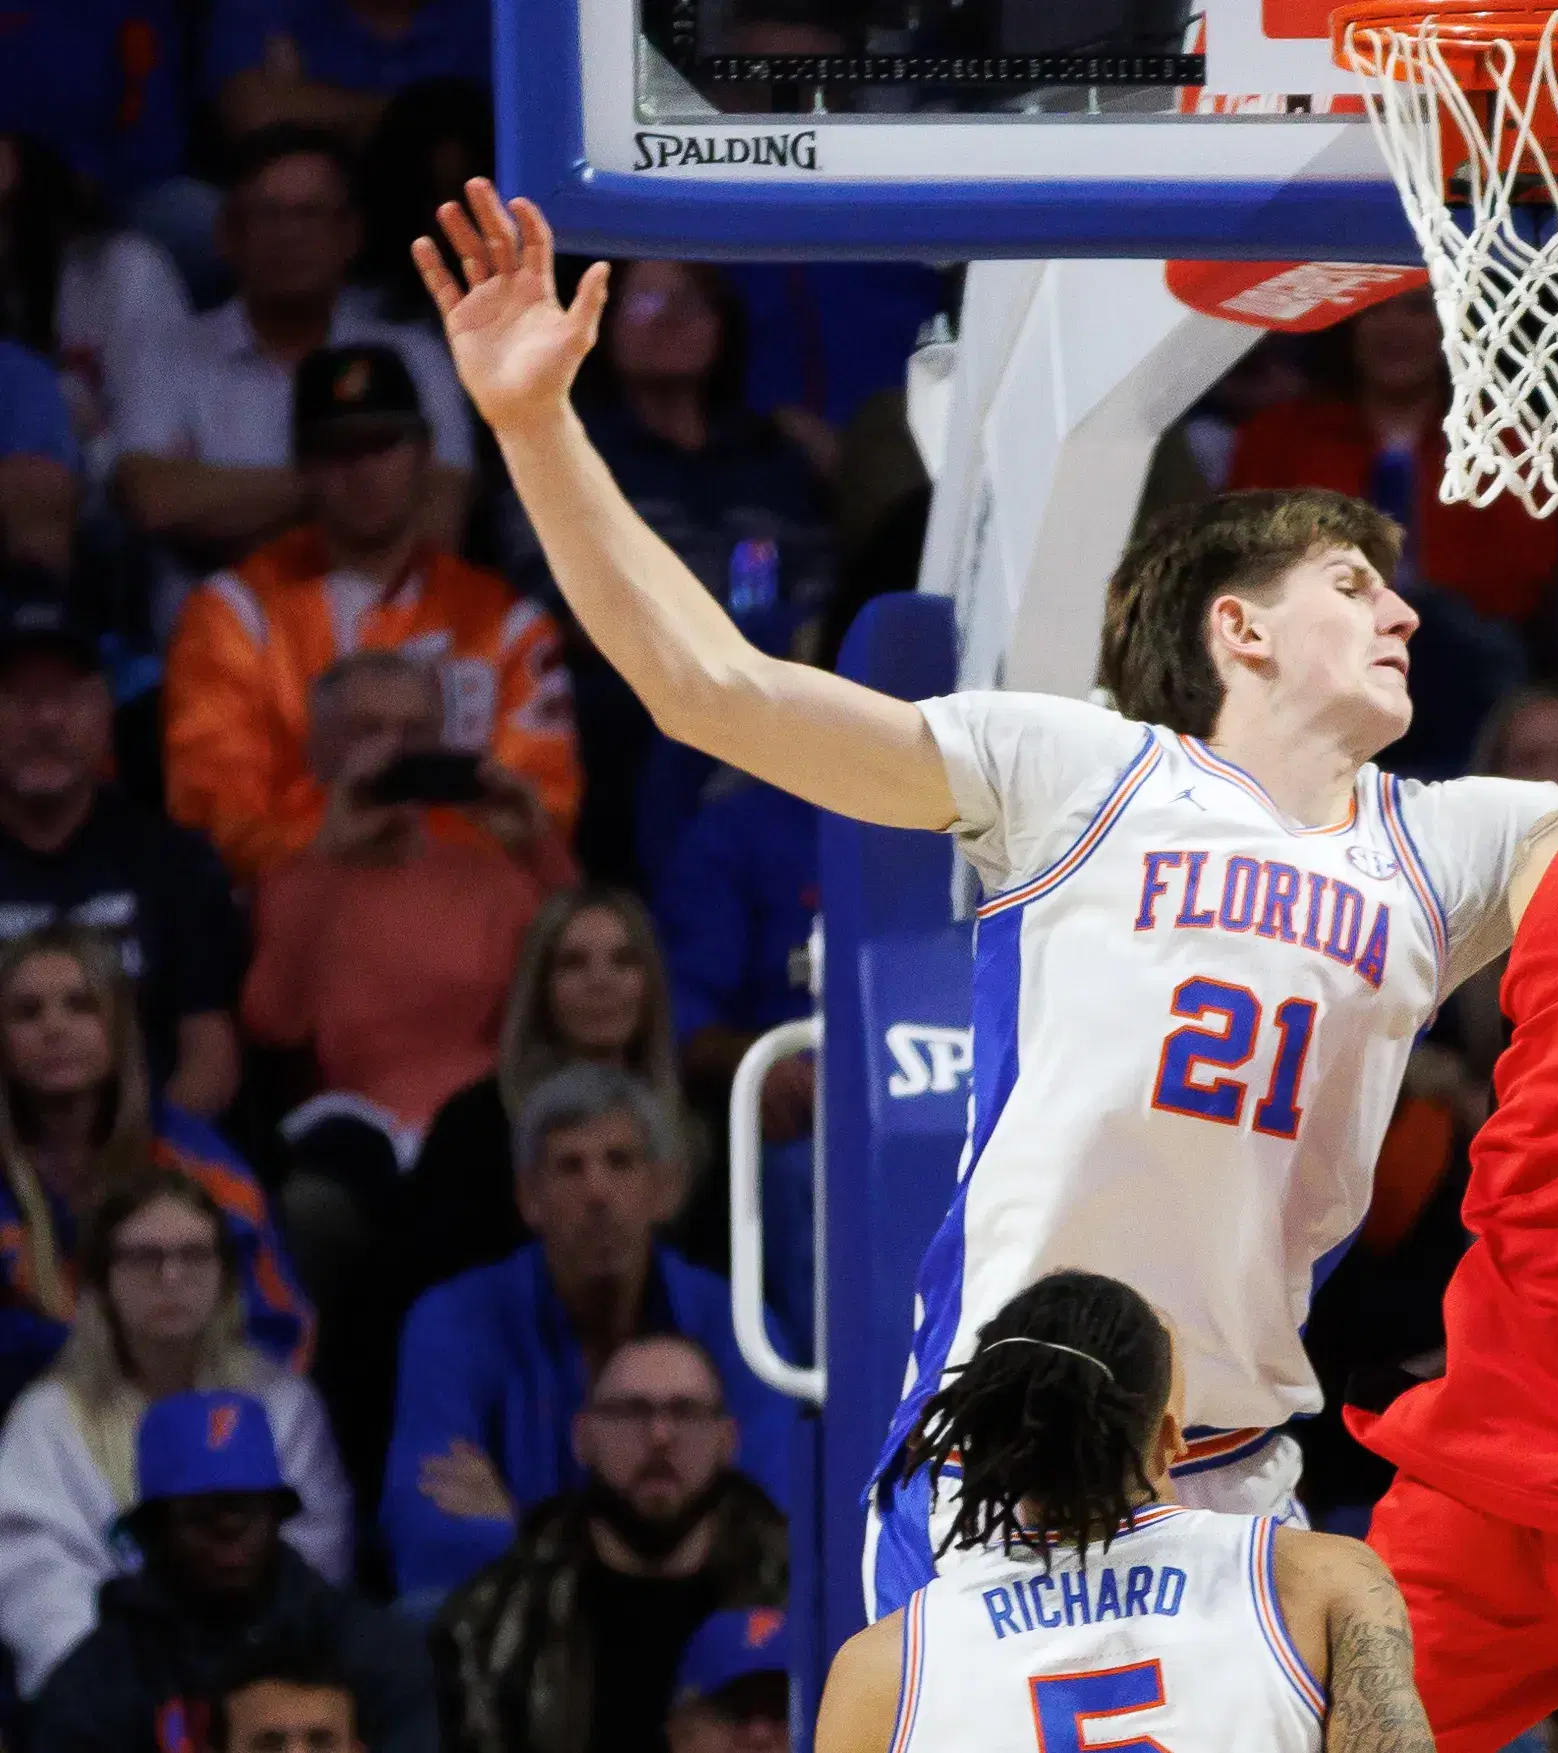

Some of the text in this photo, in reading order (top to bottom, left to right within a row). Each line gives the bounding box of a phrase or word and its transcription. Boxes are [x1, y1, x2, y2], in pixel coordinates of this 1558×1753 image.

[633, 130, 819, 171] SPALDING
[1134, 851, 1390, 990] FLORIDA
[884, 1022, 974, 1098] SP
[1151, 976, 1317, 1140] 21
[982, 1565, 1187, 1640] RICHARD
[1028, 1658, 1175, 1753] 5
